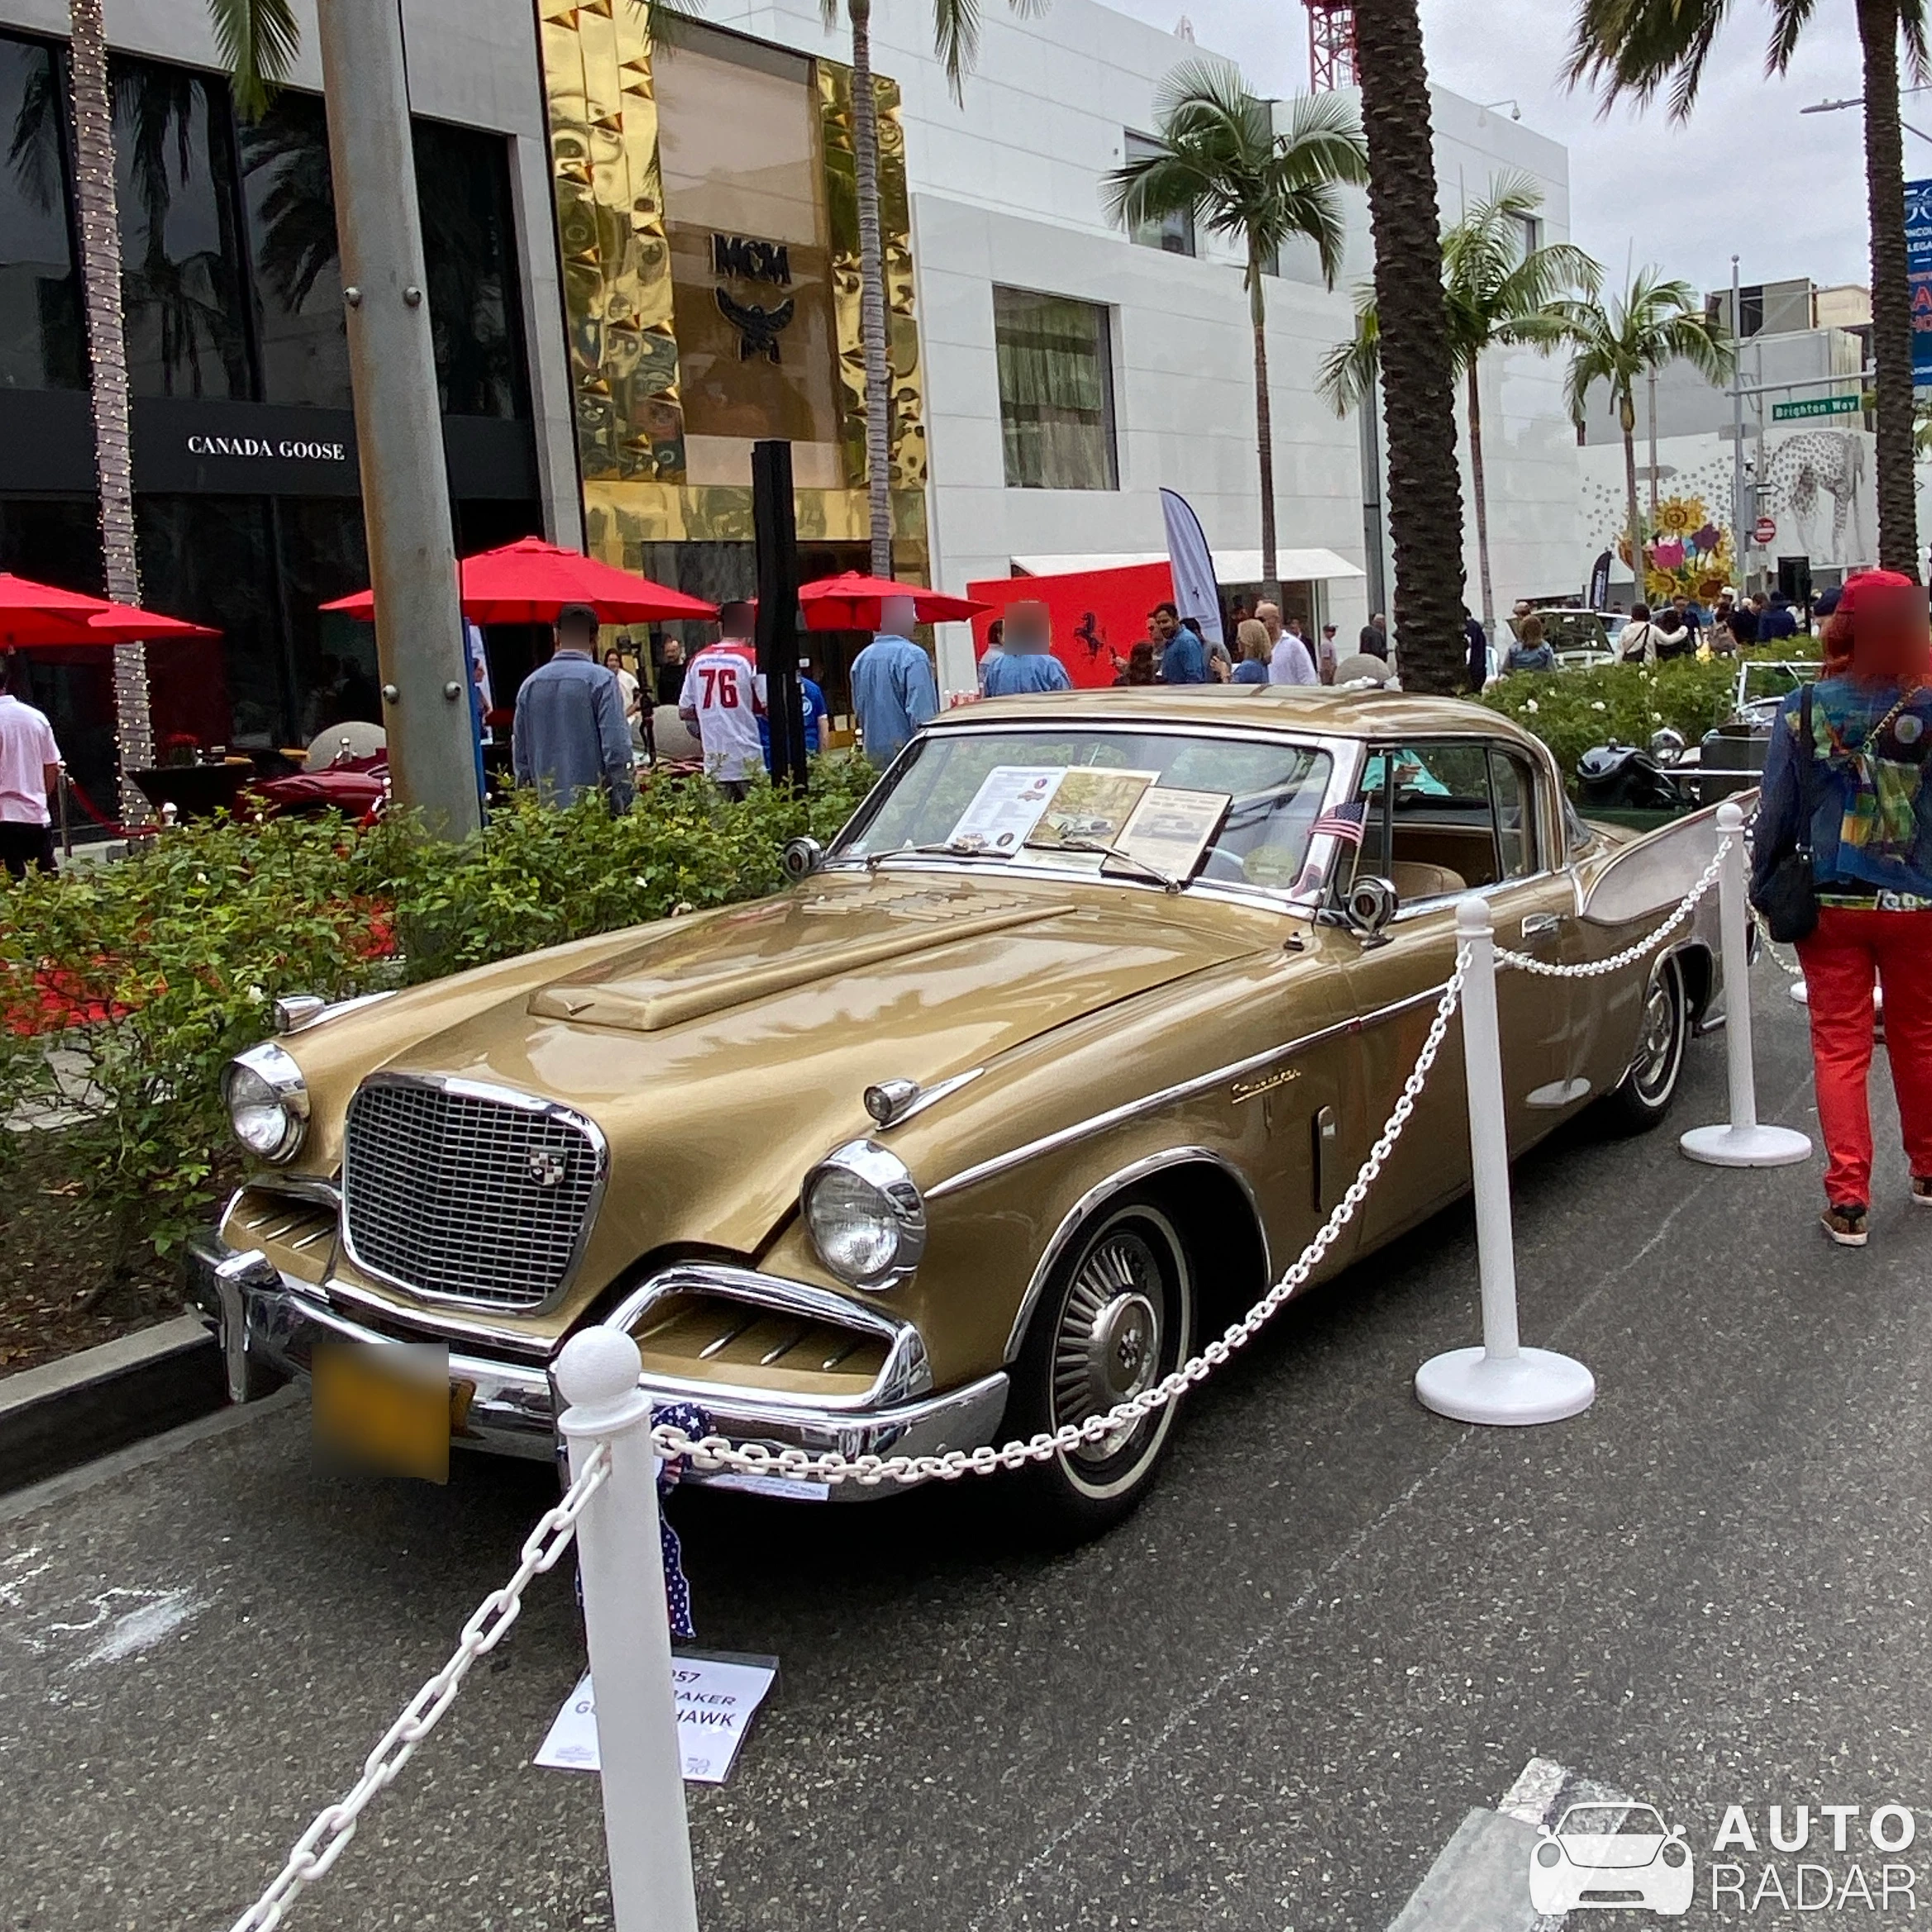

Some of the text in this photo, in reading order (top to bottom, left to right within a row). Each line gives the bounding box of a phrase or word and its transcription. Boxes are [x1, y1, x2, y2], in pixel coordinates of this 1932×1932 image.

[711, 231, 791, 284] MCM
[1776, 401, 1855, 417] Brighton Way
[188, 436, 345, 460] CANADA GOOSE
[699, 669, 738, 709] 76
